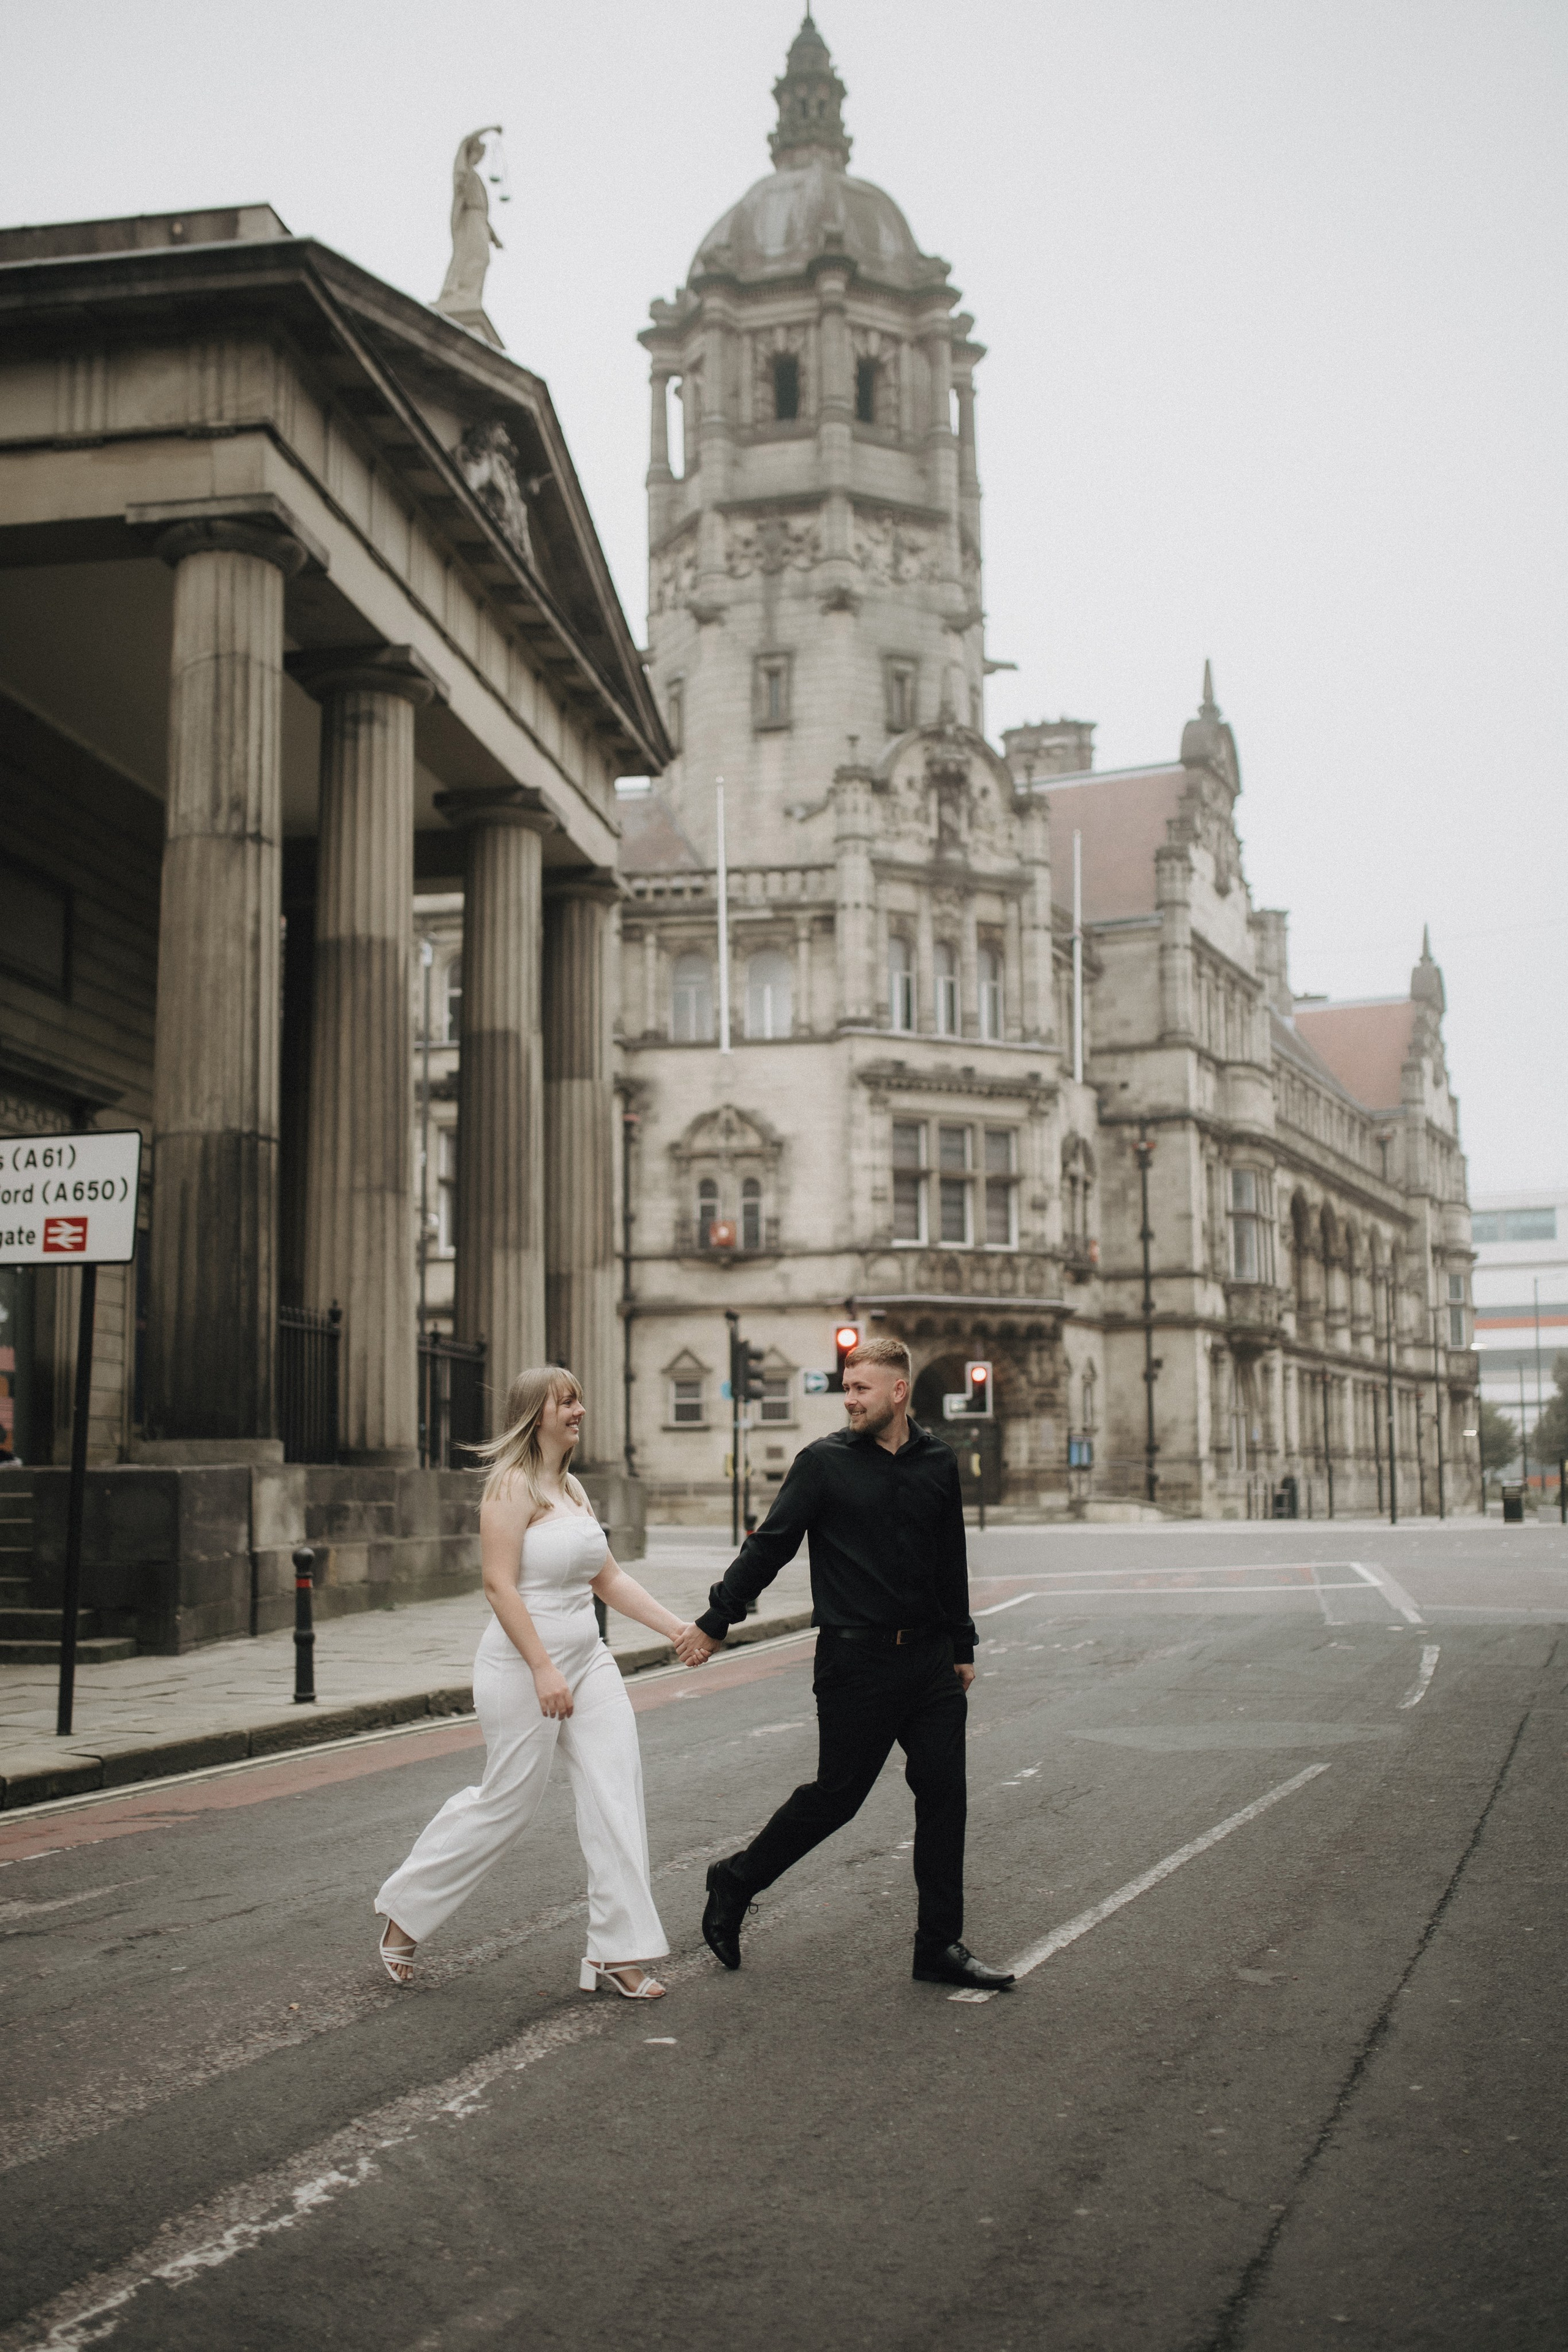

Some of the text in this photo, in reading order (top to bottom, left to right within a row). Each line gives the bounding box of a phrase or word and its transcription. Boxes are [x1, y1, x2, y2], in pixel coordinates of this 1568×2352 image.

[13, 1145, 76, 1172] (A61)
[0, 1177, 128, 1205] ord (A650)
[0, 1226, 36, 1248] ate
